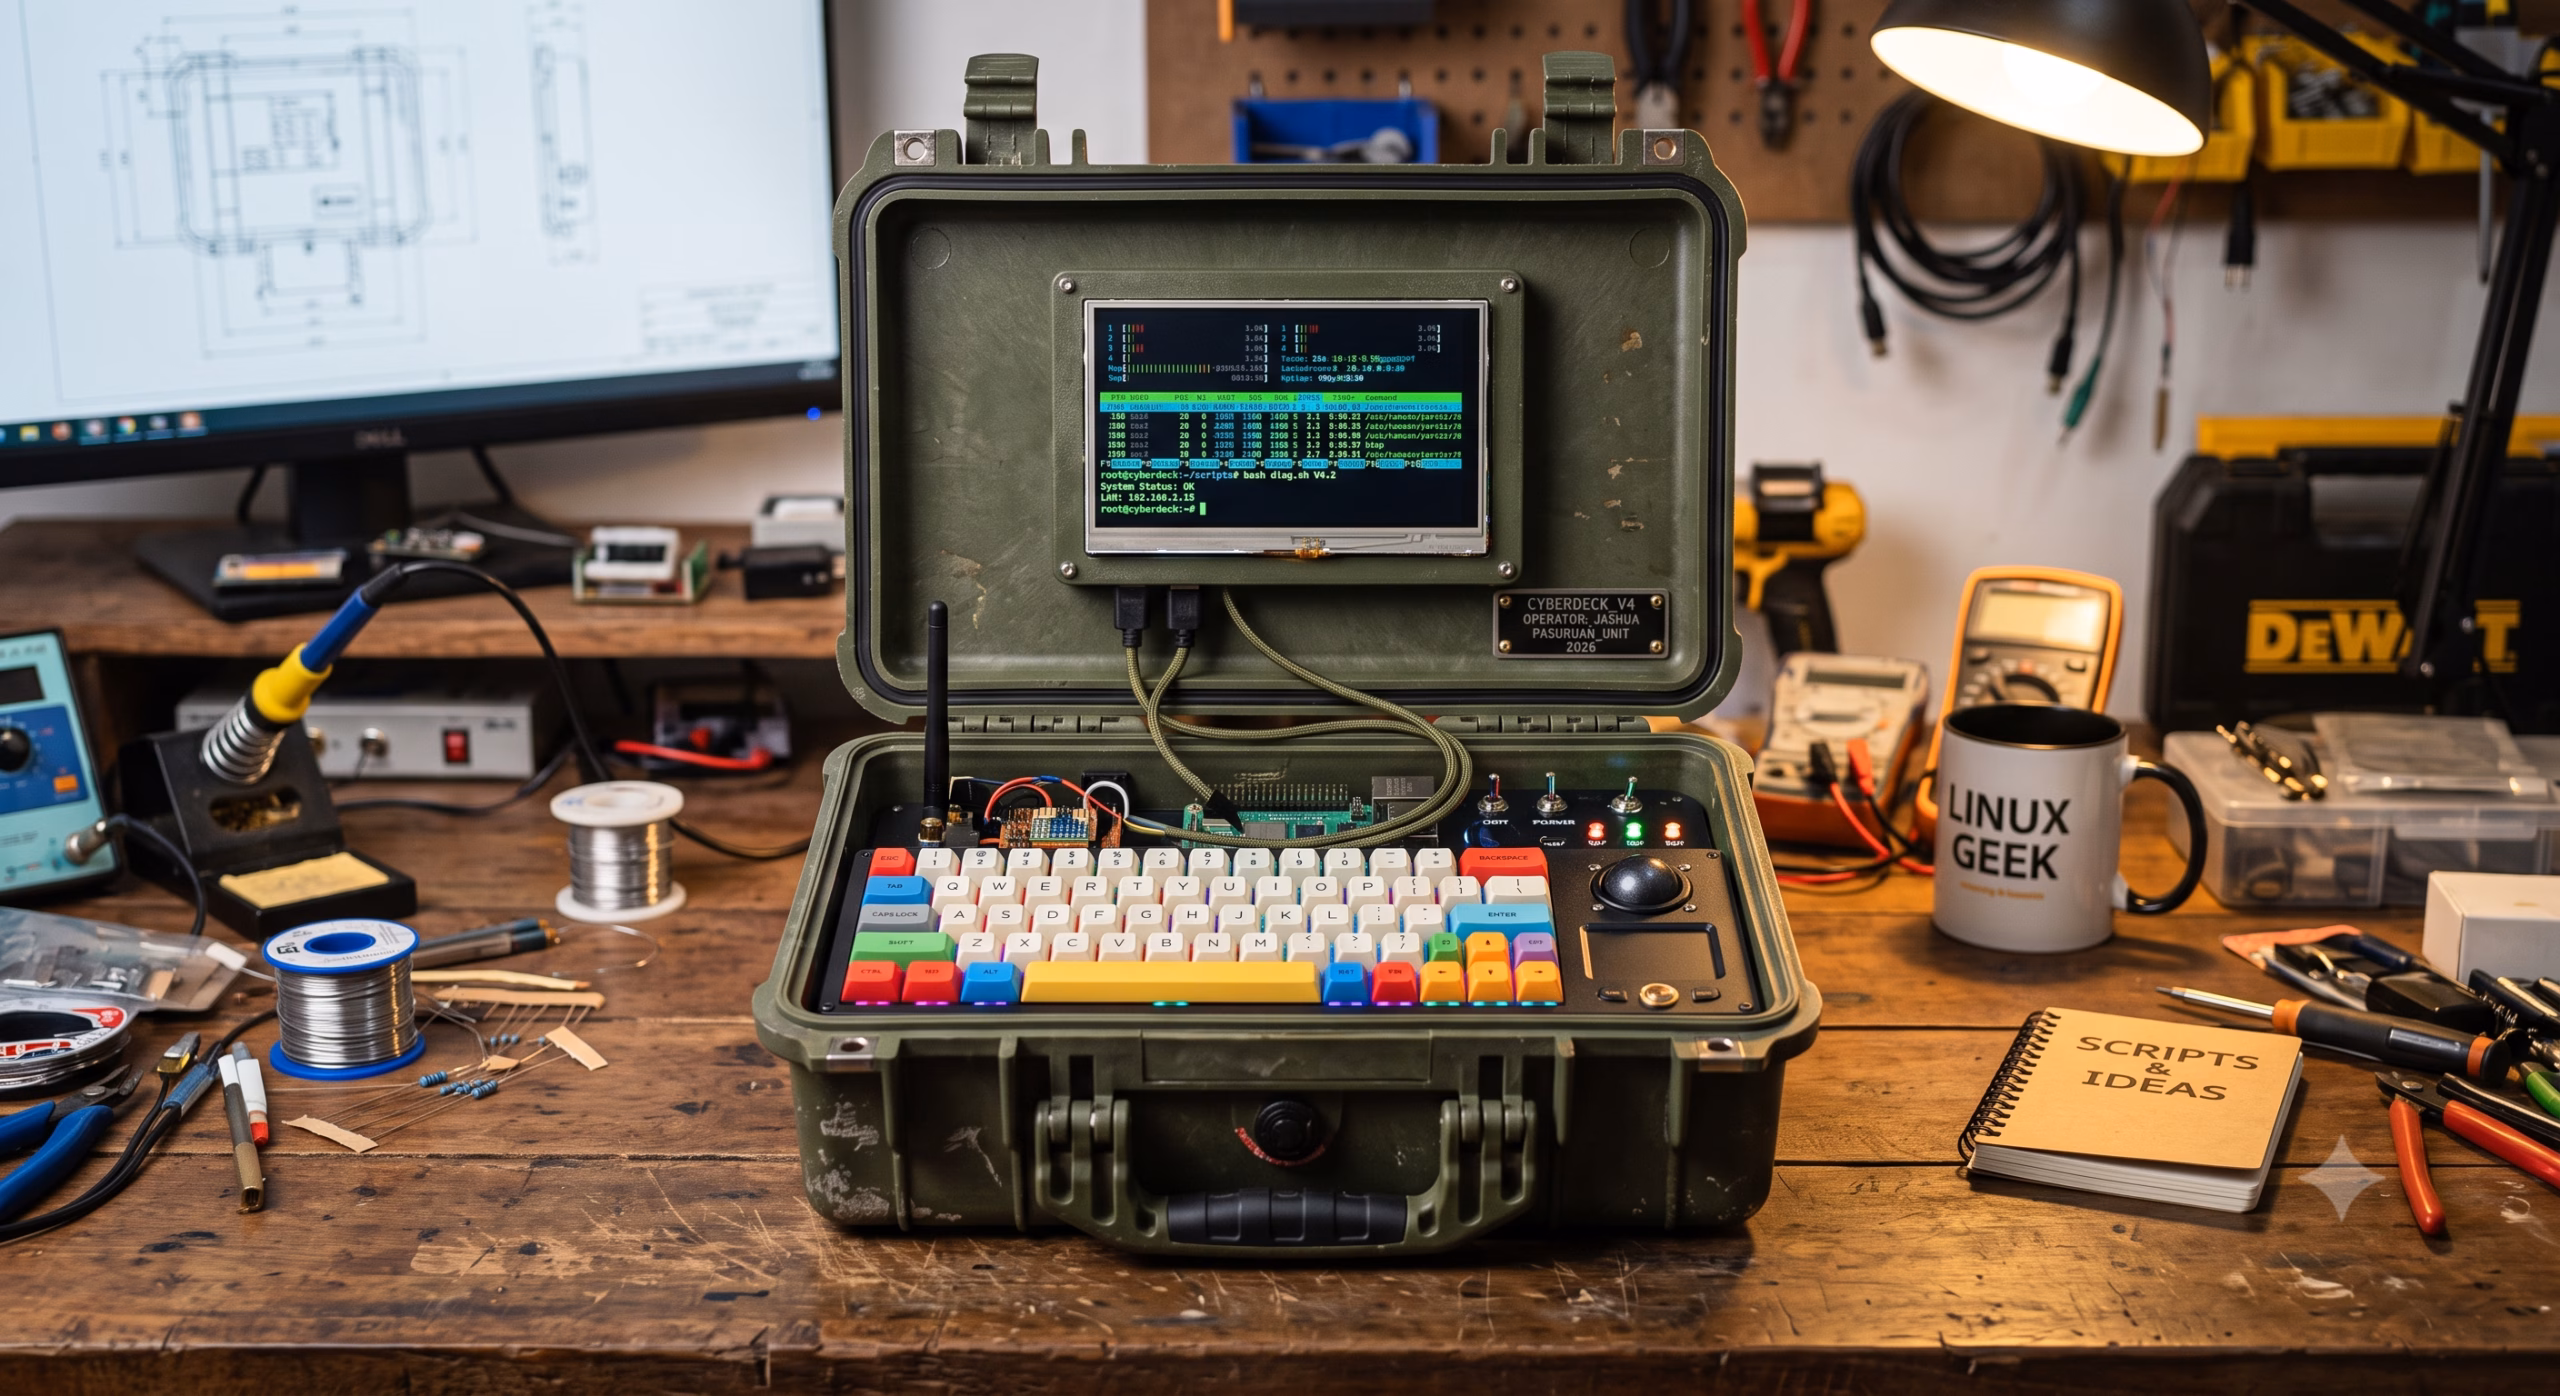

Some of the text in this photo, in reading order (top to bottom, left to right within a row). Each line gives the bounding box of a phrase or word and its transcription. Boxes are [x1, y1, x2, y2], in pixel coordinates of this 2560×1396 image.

[1243, 471, 1266, 479] bash
[1313, 471, 1337, 479] V4.2
[1100, 482, 1195, 493] System Status: OK
[1527, 597, 1636, 613] CYBERDECK_V4
[1523, 614, 1589, 625] OPERATOR:
[1532, 627, 1630, 642] PASURUAN_UNIT
[1566, 642, 1597, 653] 2026
[1949, 783, 2071, 835] LINUX
[1952, 833, 2060, 880] GEEK
[947, 882, 958, 891] Q
[993, 882, 1006, 891] W
[1041, 882, 1050, 891] E
[1086, 882, 1096, 891] R
[1133, 882, 1142, 891] T
[1178, 882, 1188, 891] Y
[1224, 882, 1235, 891] U
[1315, 882, 1327, 891] O
[1363, 882, 1373, 891] P
[954, 911, 965, 919] A
[1001, 911, 1010, 919] S
[1048, 911, 1058, 919] D
[1094, 911, 1104, 919] F
[1141, 911, 1152, 919] G
[1187, 911, 1197, 919] H
[1236, 911, 1243, 919] J
[1281, 911, 1291, 919] K
[1328, 911, 1337, 919] L
[972, 939, 982, 947] Z
[1020, 939, 1030, 947] X
[1067, 939, 1078, 947] C
[1114, 939, 1124, 947] V
[1162, 939, 1171, 947] B
[1209, 939, 1218, 947] N
[1255, 939, 1266, 947] M
[2076, 1036, 2260, 1070] SCRIPTS
[2145, 1062, 2172, 1076] &
[2081, 1070, 2228, 1101] IDEAS
